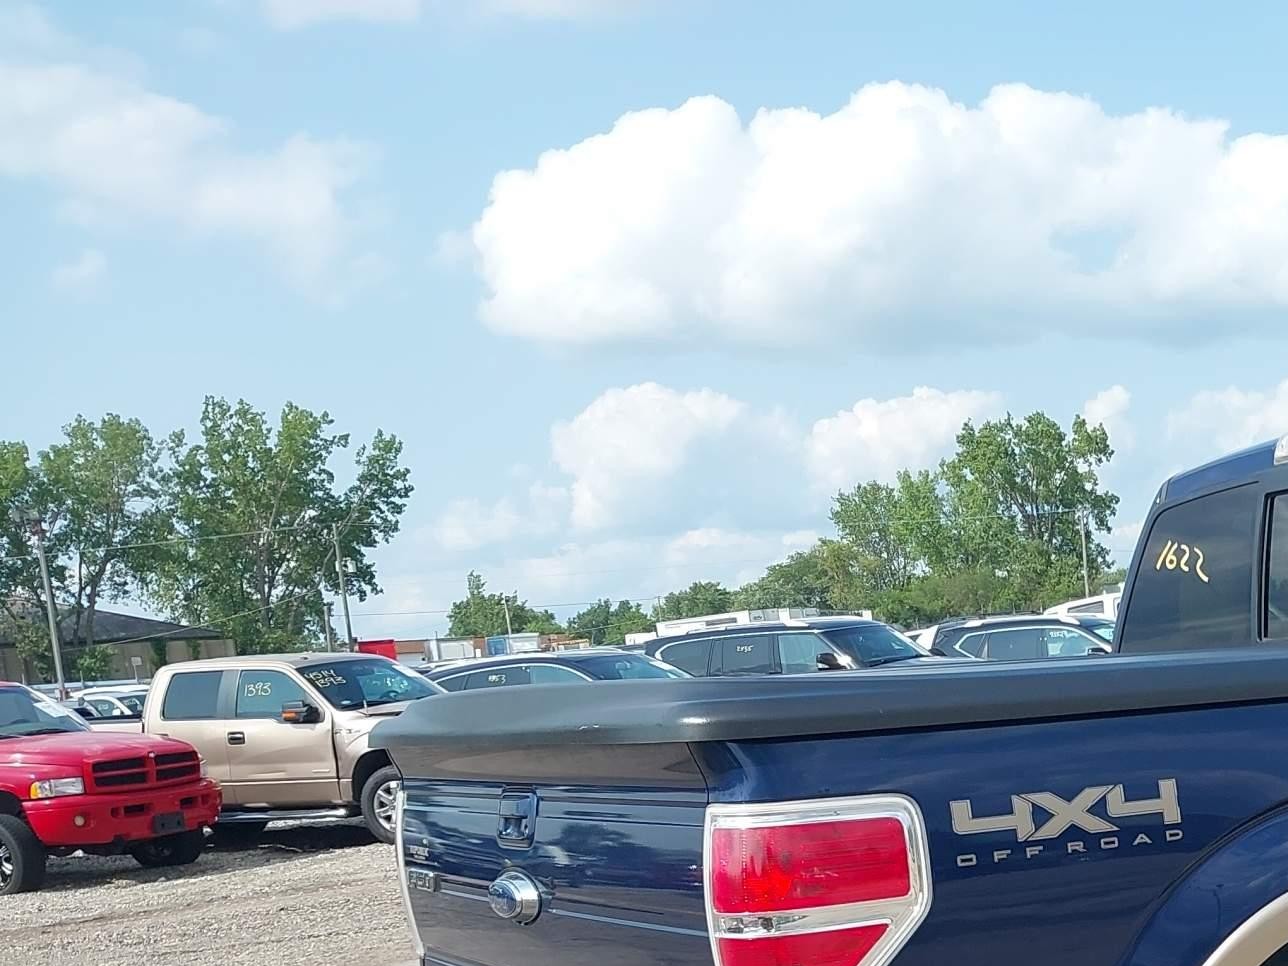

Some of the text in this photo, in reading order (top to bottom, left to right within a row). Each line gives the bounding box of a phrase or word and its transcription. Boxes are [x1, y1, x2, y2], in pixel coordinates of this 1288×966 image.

[1155, 539, 1209, 583] 1622
[244, 681, 272, 697] 1393
[949, 778, 1182, 842] 4X4
[957, 829, 1184, 867] OFF ROAD
